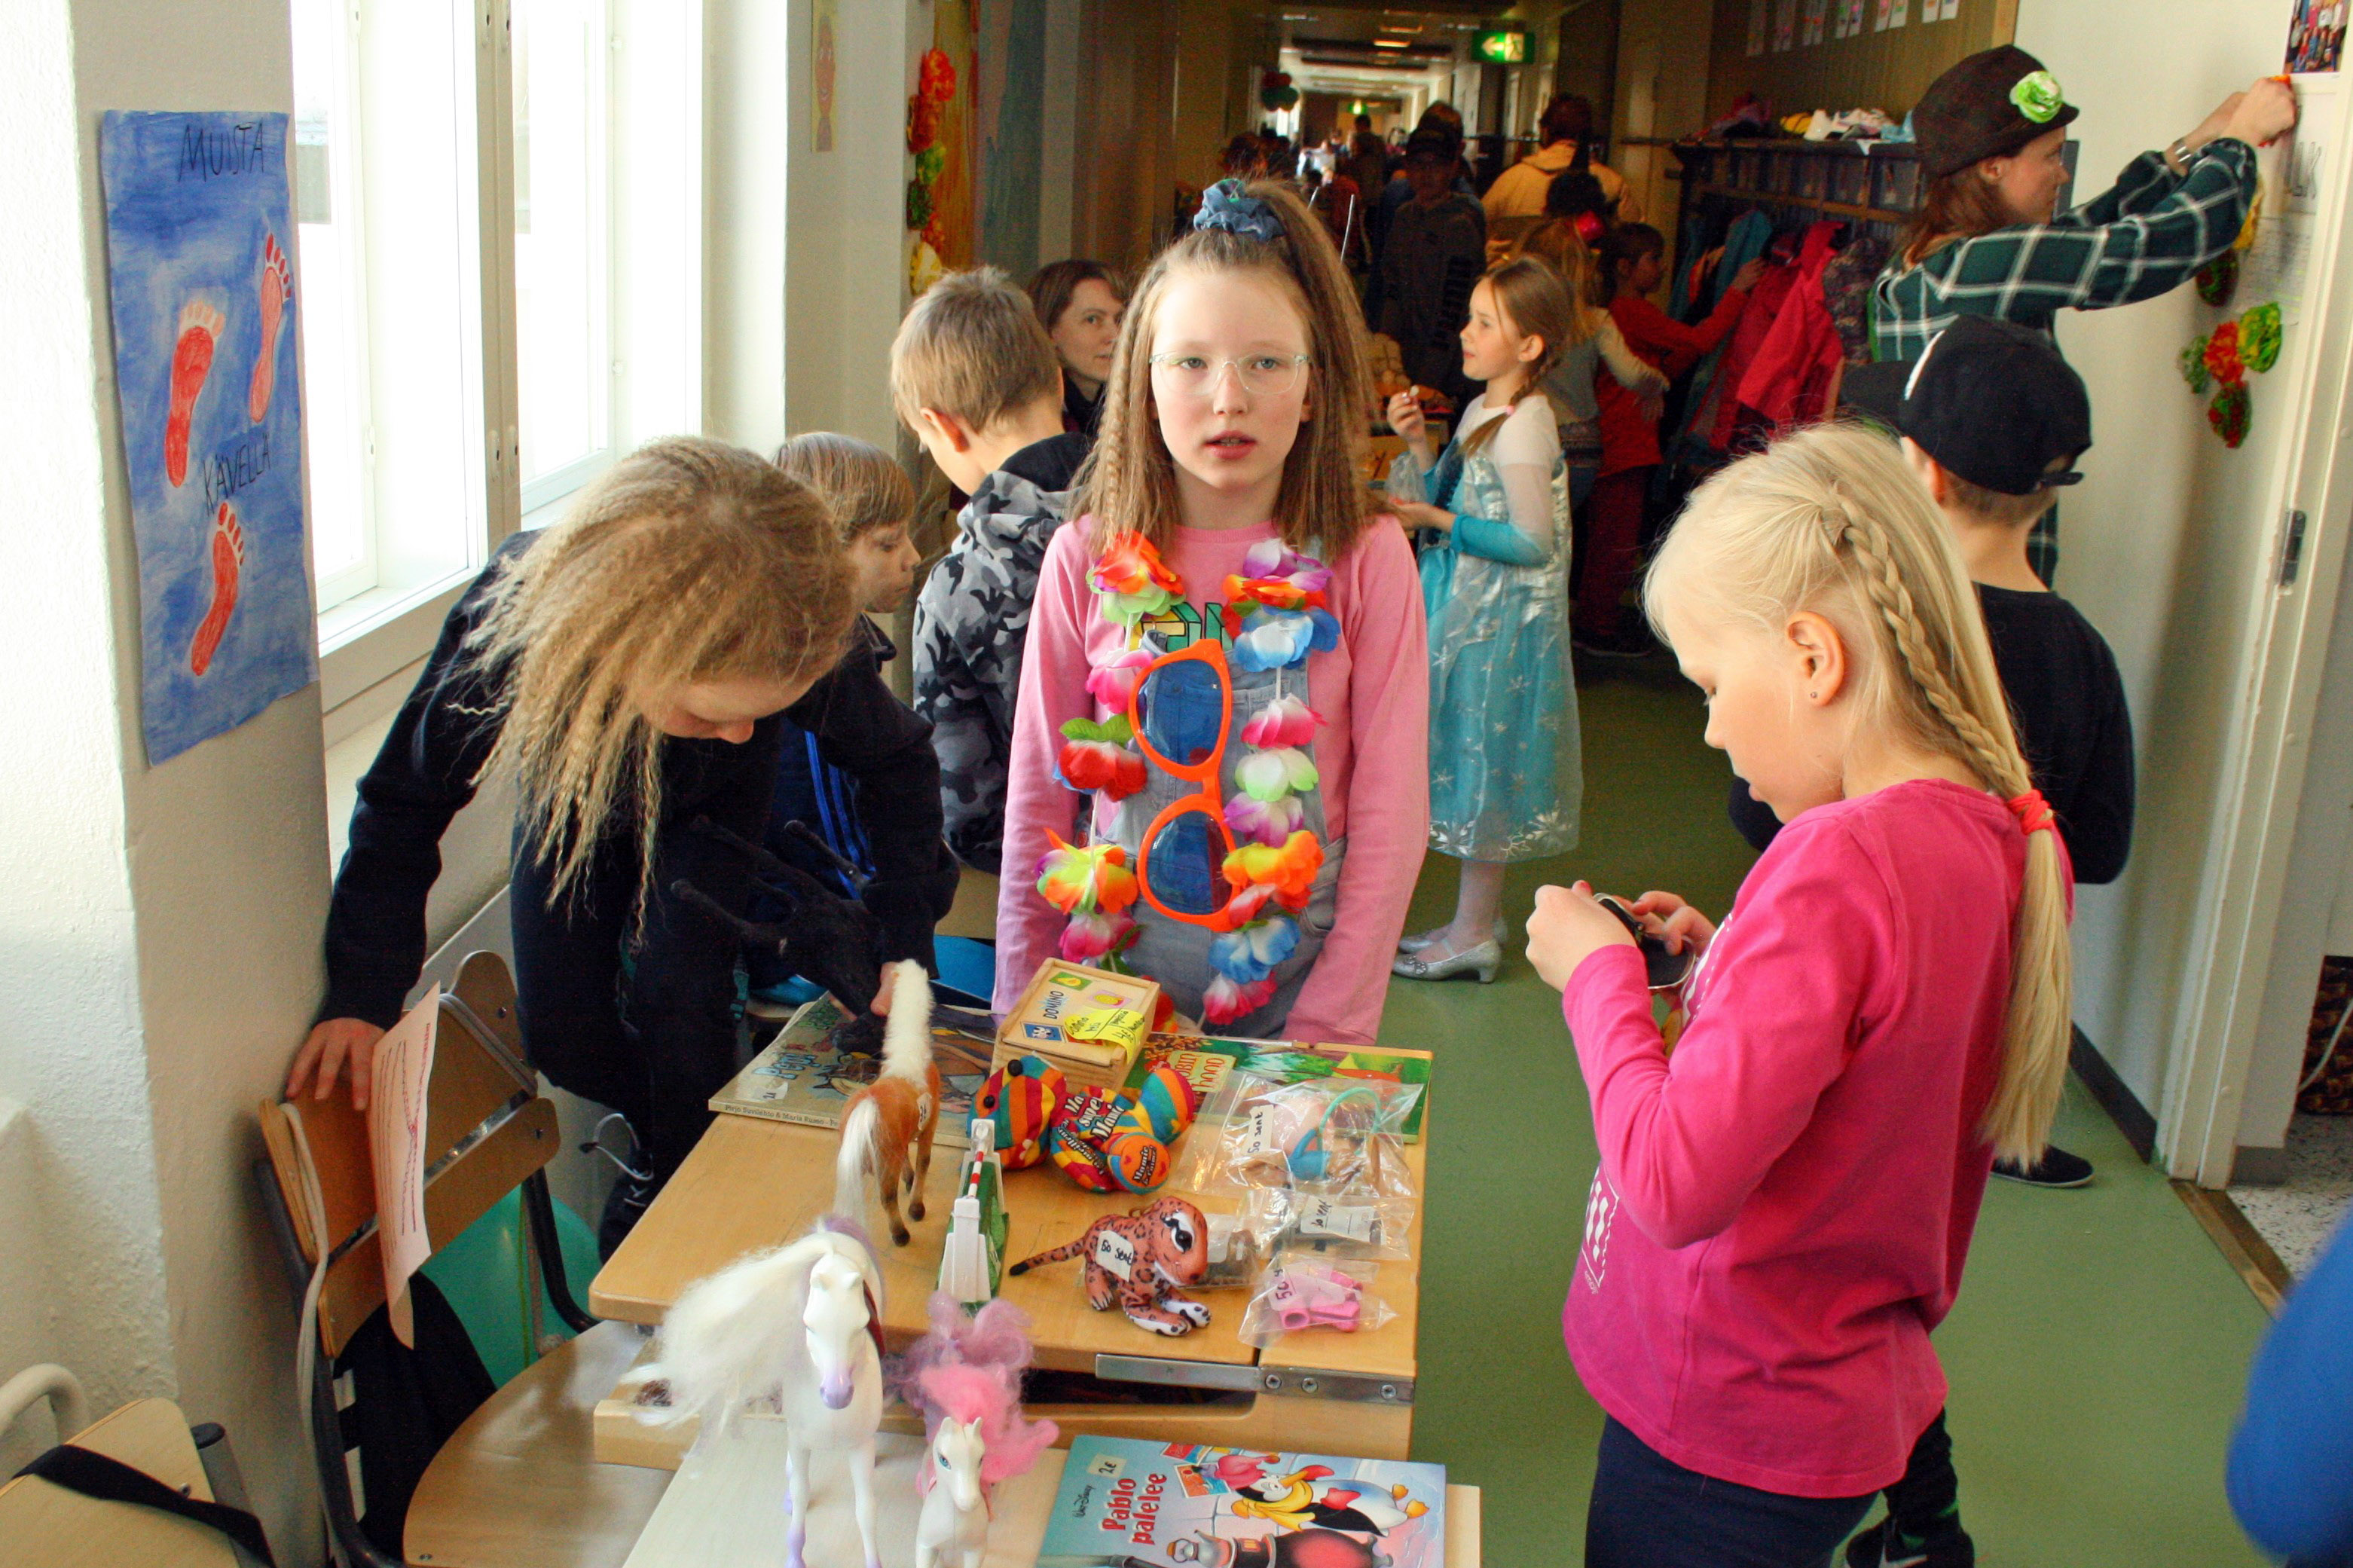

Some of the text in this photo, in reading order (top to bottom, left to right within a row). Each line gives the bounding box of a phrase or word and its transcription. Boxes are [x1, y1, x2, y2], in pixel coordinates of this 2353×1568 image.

[178, 118, 264, 182] MUISTA
[203, 432, 270, 517] KÄVELLÄ
[1043, 990, 1064, 1019] DOMINO
[1175, 1053, 1202, 1084] OBIN
[1101, 1478, 1136, 1530] Pablo
[1132, 1473, 1167, 1545] palelee
